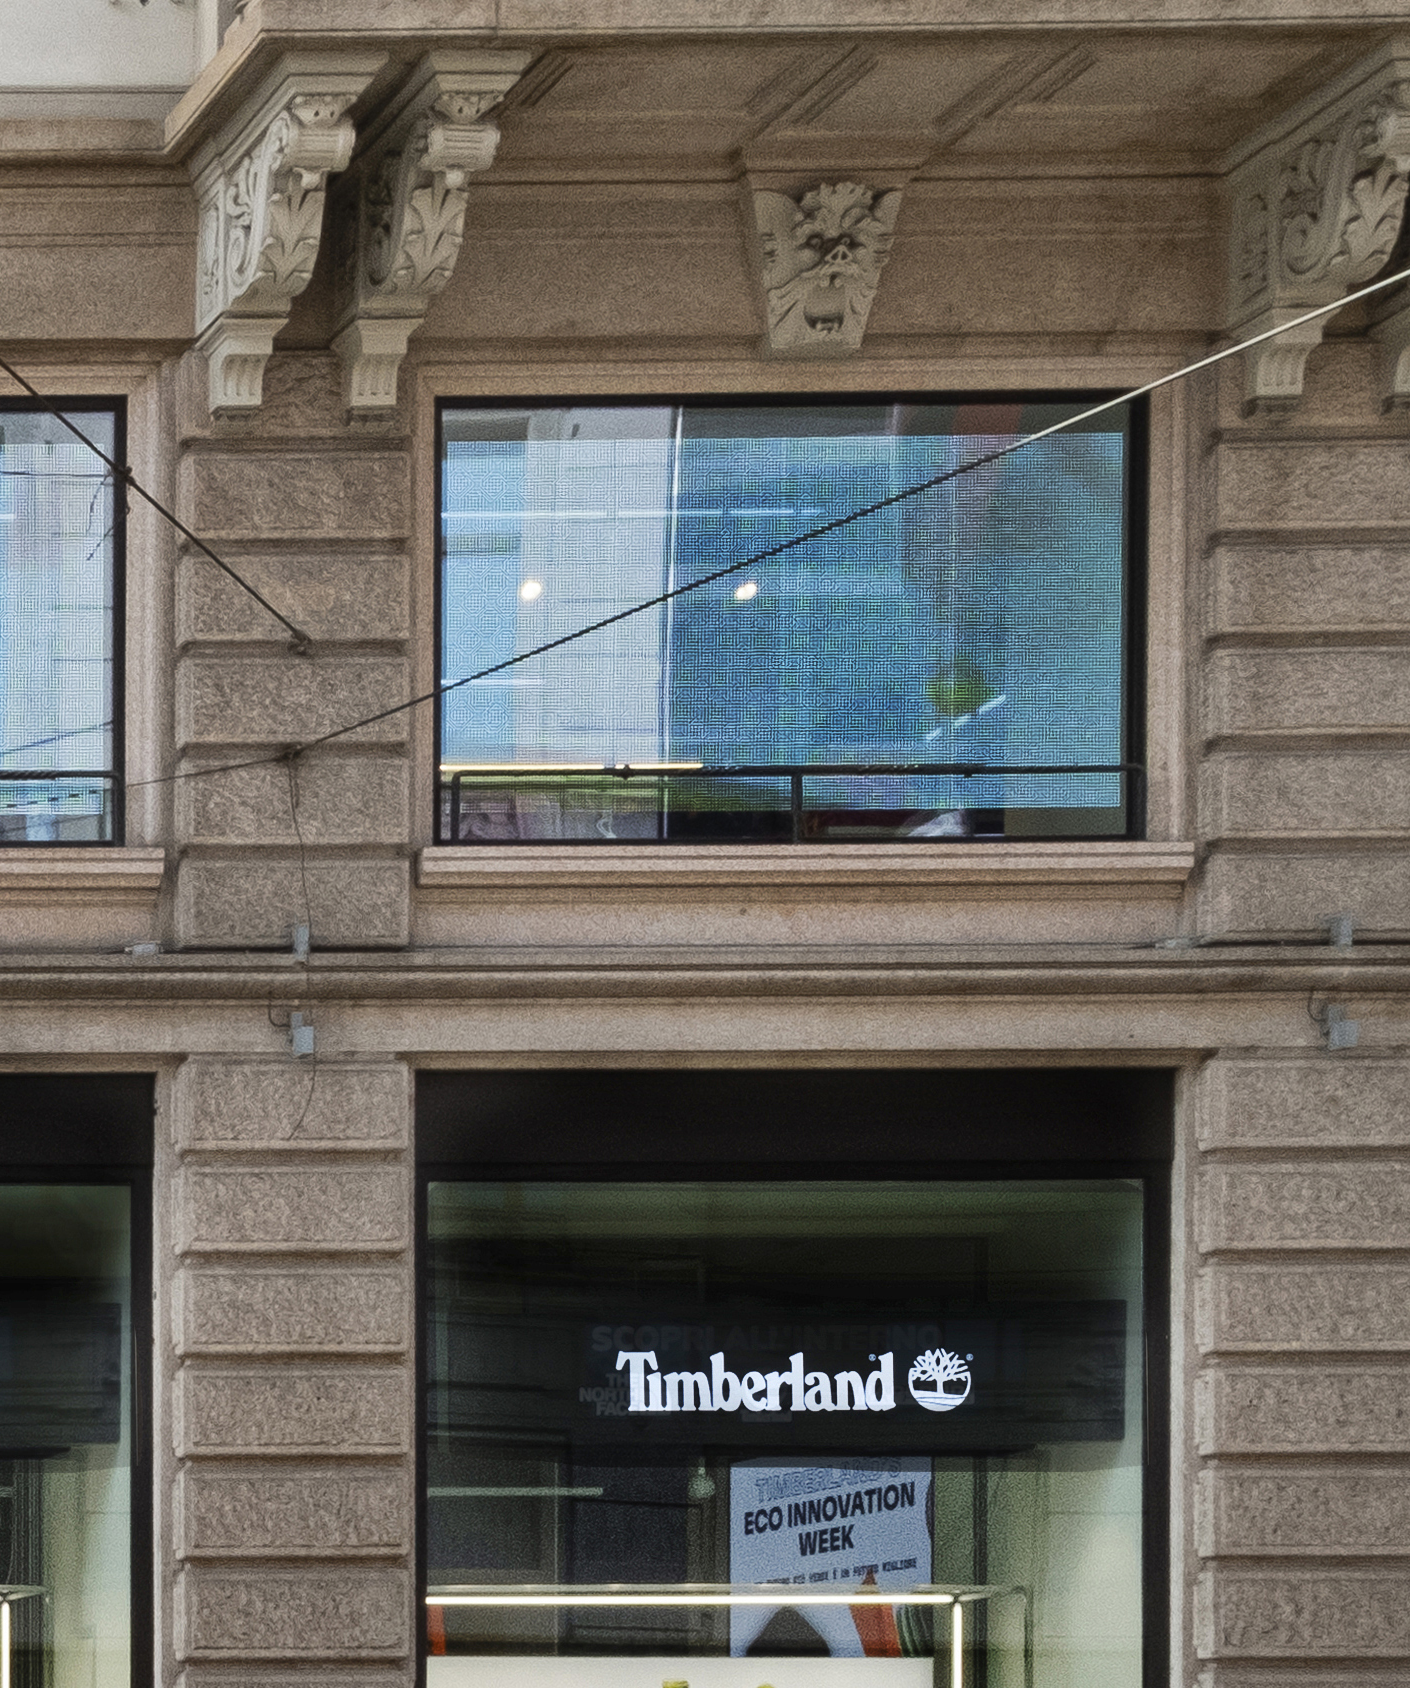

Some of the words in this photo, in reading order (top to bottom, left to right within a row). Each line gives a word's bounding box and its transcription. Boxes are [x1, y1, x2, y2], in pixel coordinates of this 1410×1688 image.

[616, 1349, 895, 1413] Timberland
[744, 1506, 783, 1535] ECO
[787, 1481, 915, 1528] INNOVATION
[798, 1524, 855, 1556] WEEK
